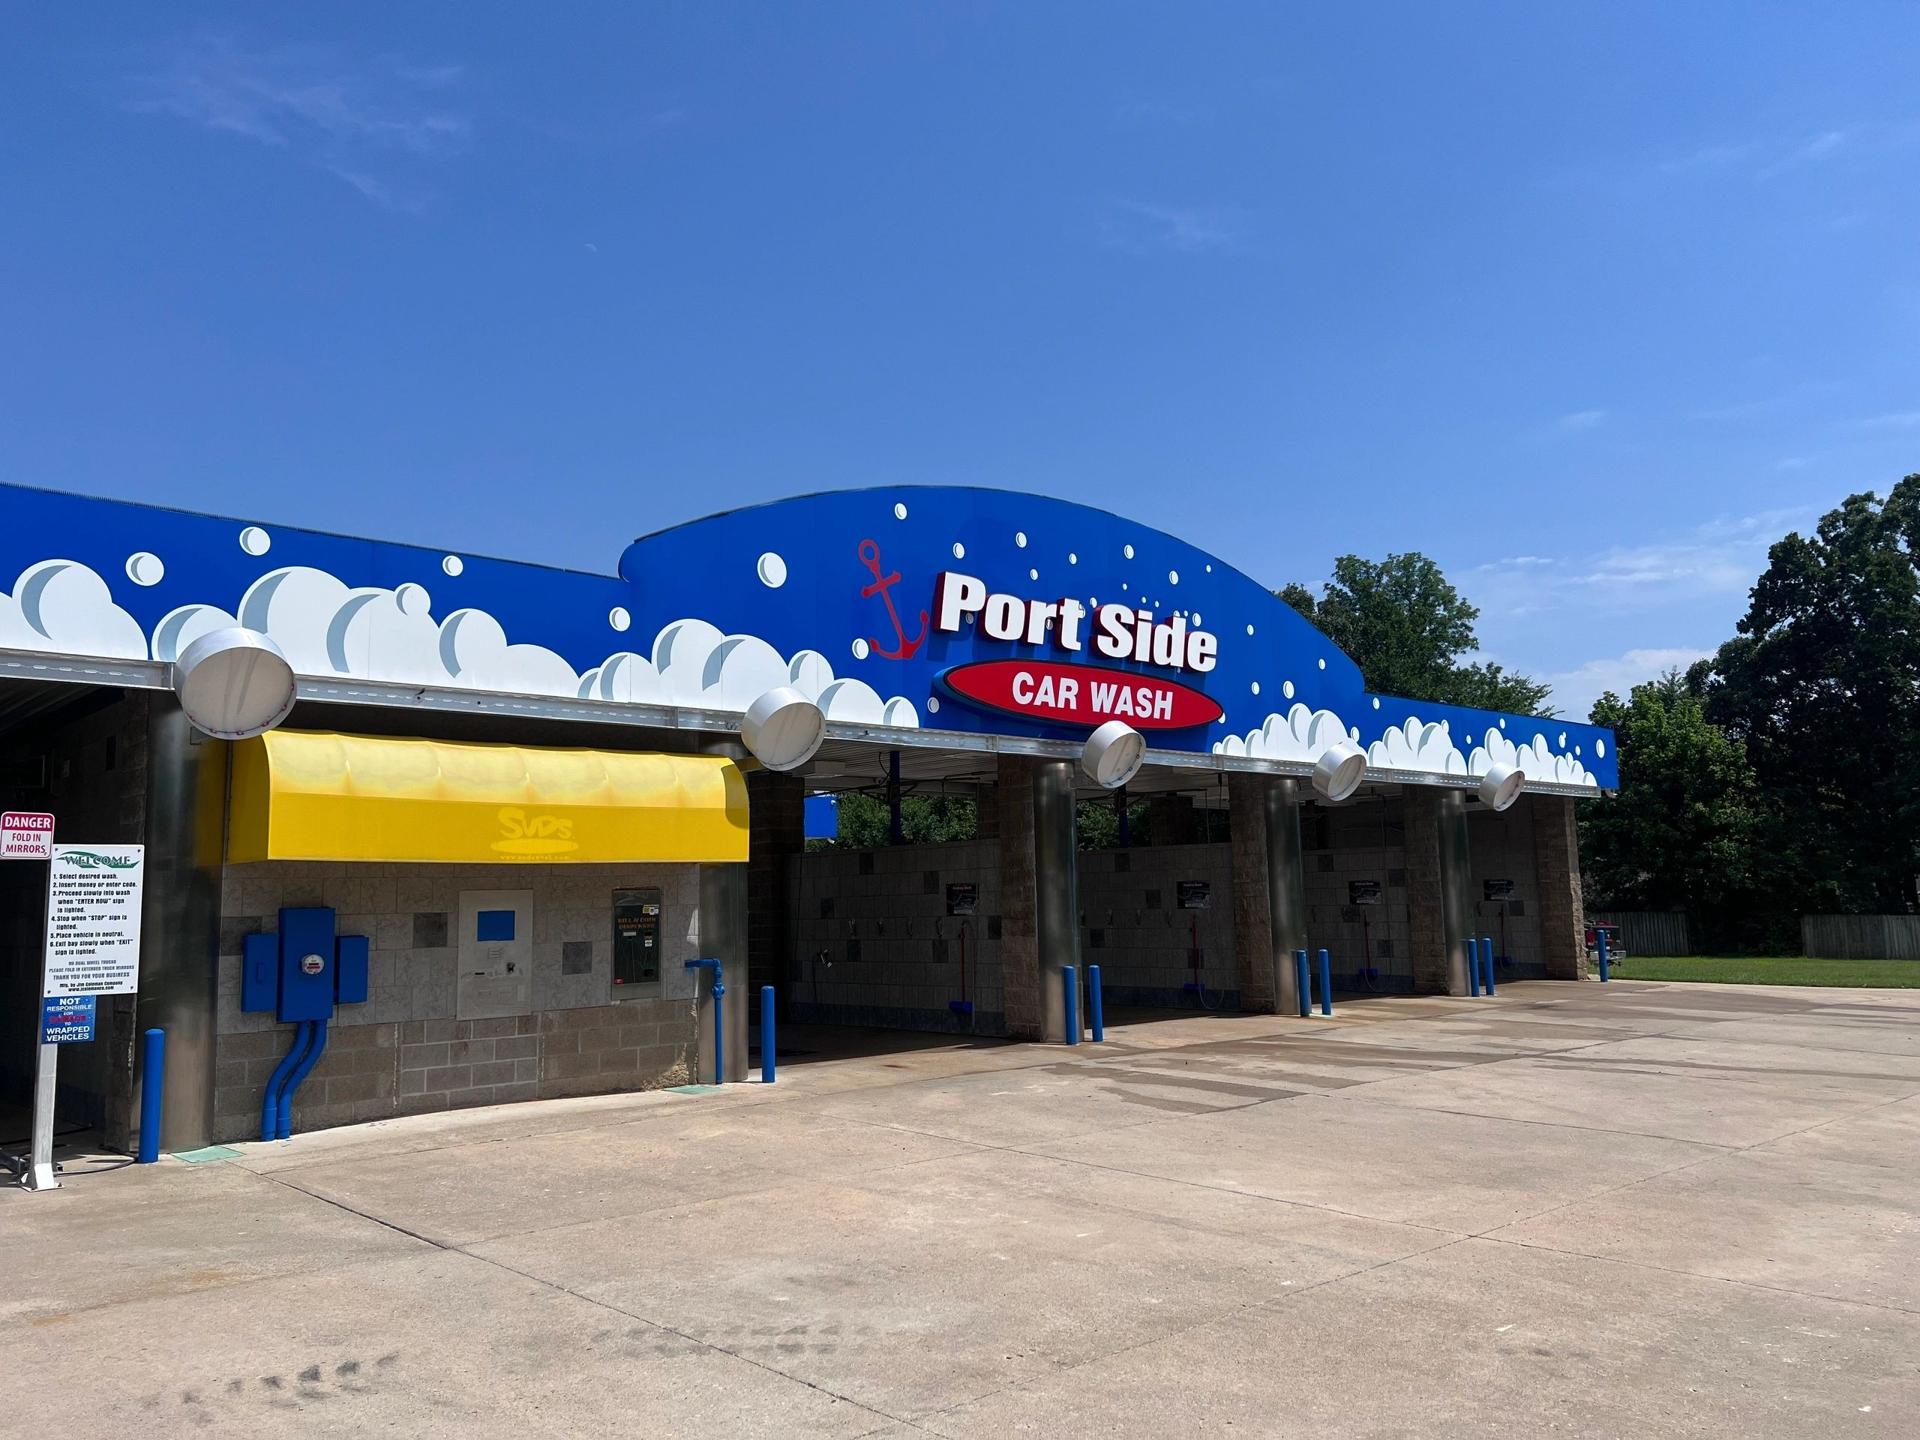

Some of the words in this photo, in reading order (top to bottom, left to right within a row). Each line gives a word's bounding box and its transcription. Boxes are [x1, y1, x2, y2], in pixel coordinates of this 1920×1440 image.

[935, 571, 1084, 651] Port
[1096, 603, 1217, 672] Side
[1012, 671, 1079, 710] CAR
[1090, 681, 1173, 720] WASH
[5, 817, 51, 828] DANGER
[12, 832, 31, 841] FOLD
[32, 833, 41, 842] IN
[6, 844, 45, 853] MIRRORS
[64, 856, 131, 865] WELCOME
[47, 1026, 90, 1034] WRAPPED
[47, 1033, 89, 1041] VEHICLES
